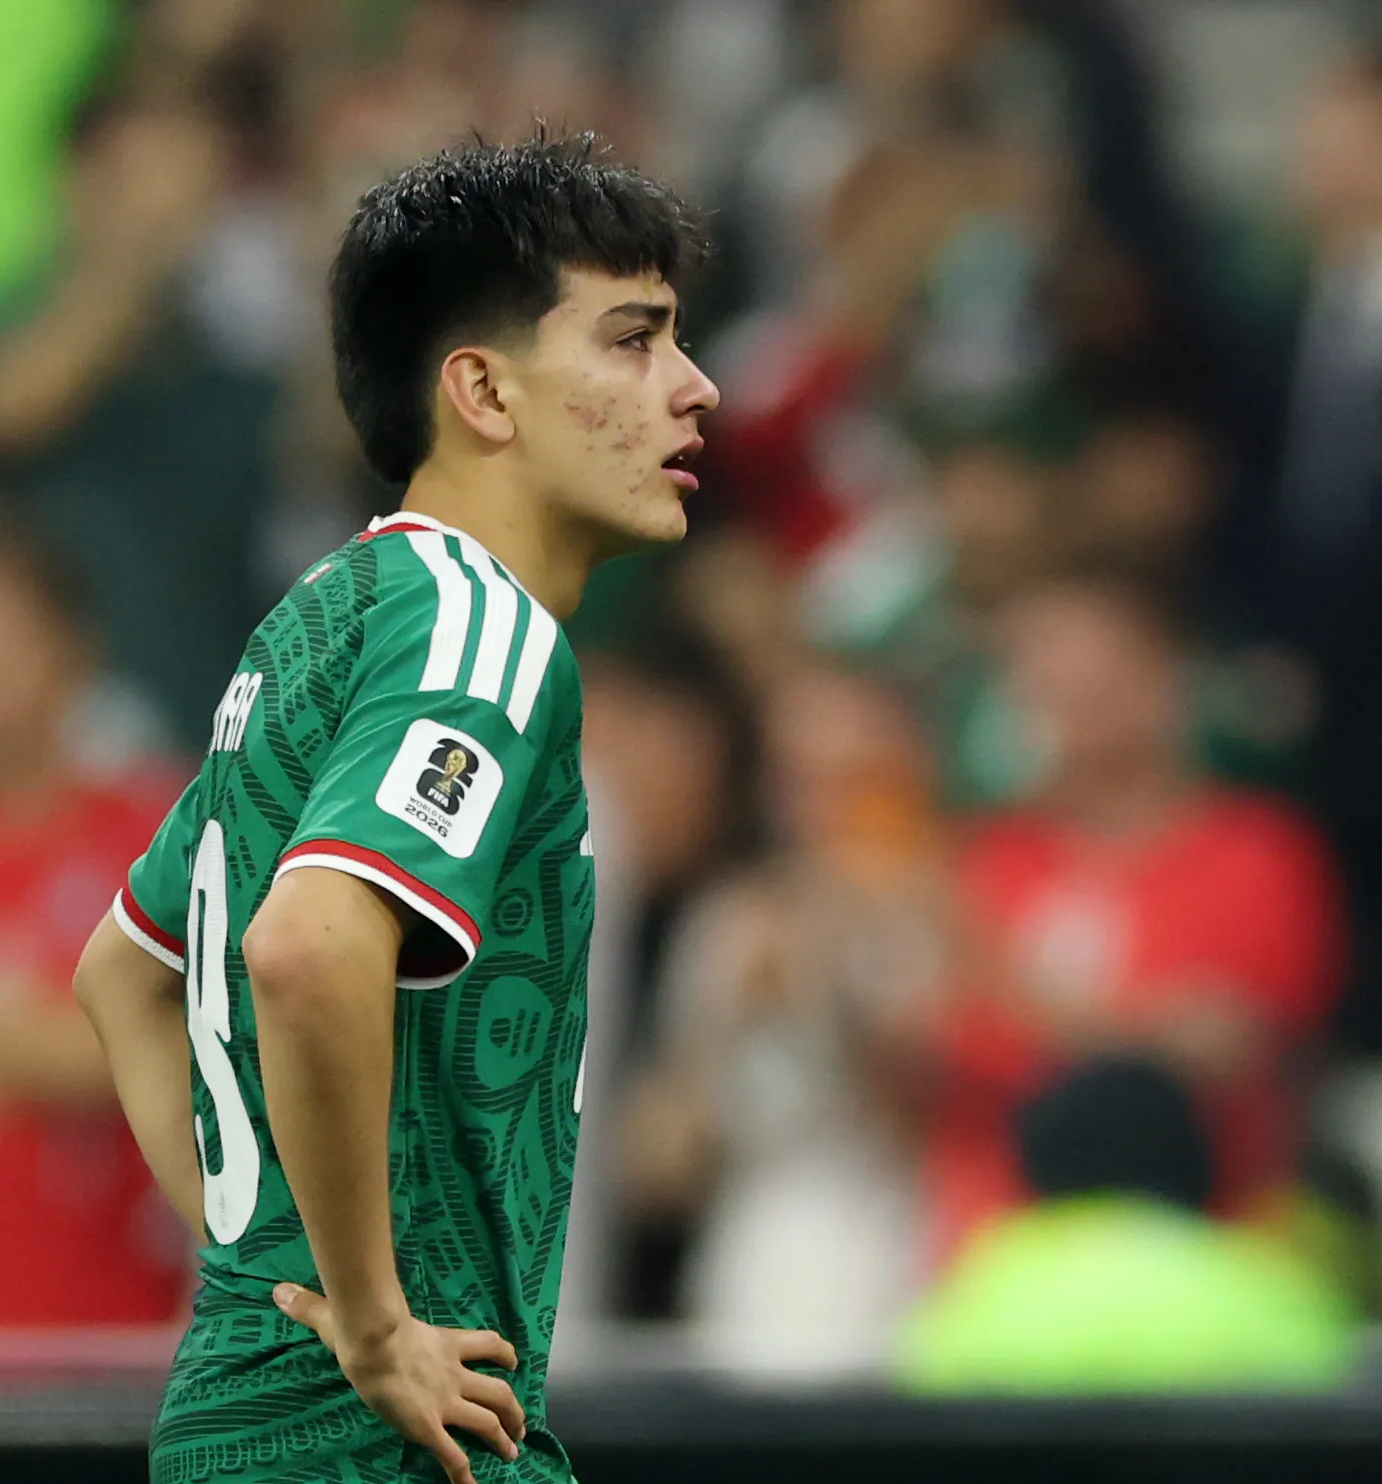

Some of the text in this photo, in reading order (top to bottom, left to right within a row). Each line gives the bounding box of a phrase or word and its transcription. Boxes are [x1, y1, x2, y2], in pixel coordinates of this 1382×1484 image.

[409, 796, 454, 828] WORLD CUP
[427, 787, 450, 808] FIFA
[404, 803, 449, 838] 2026
